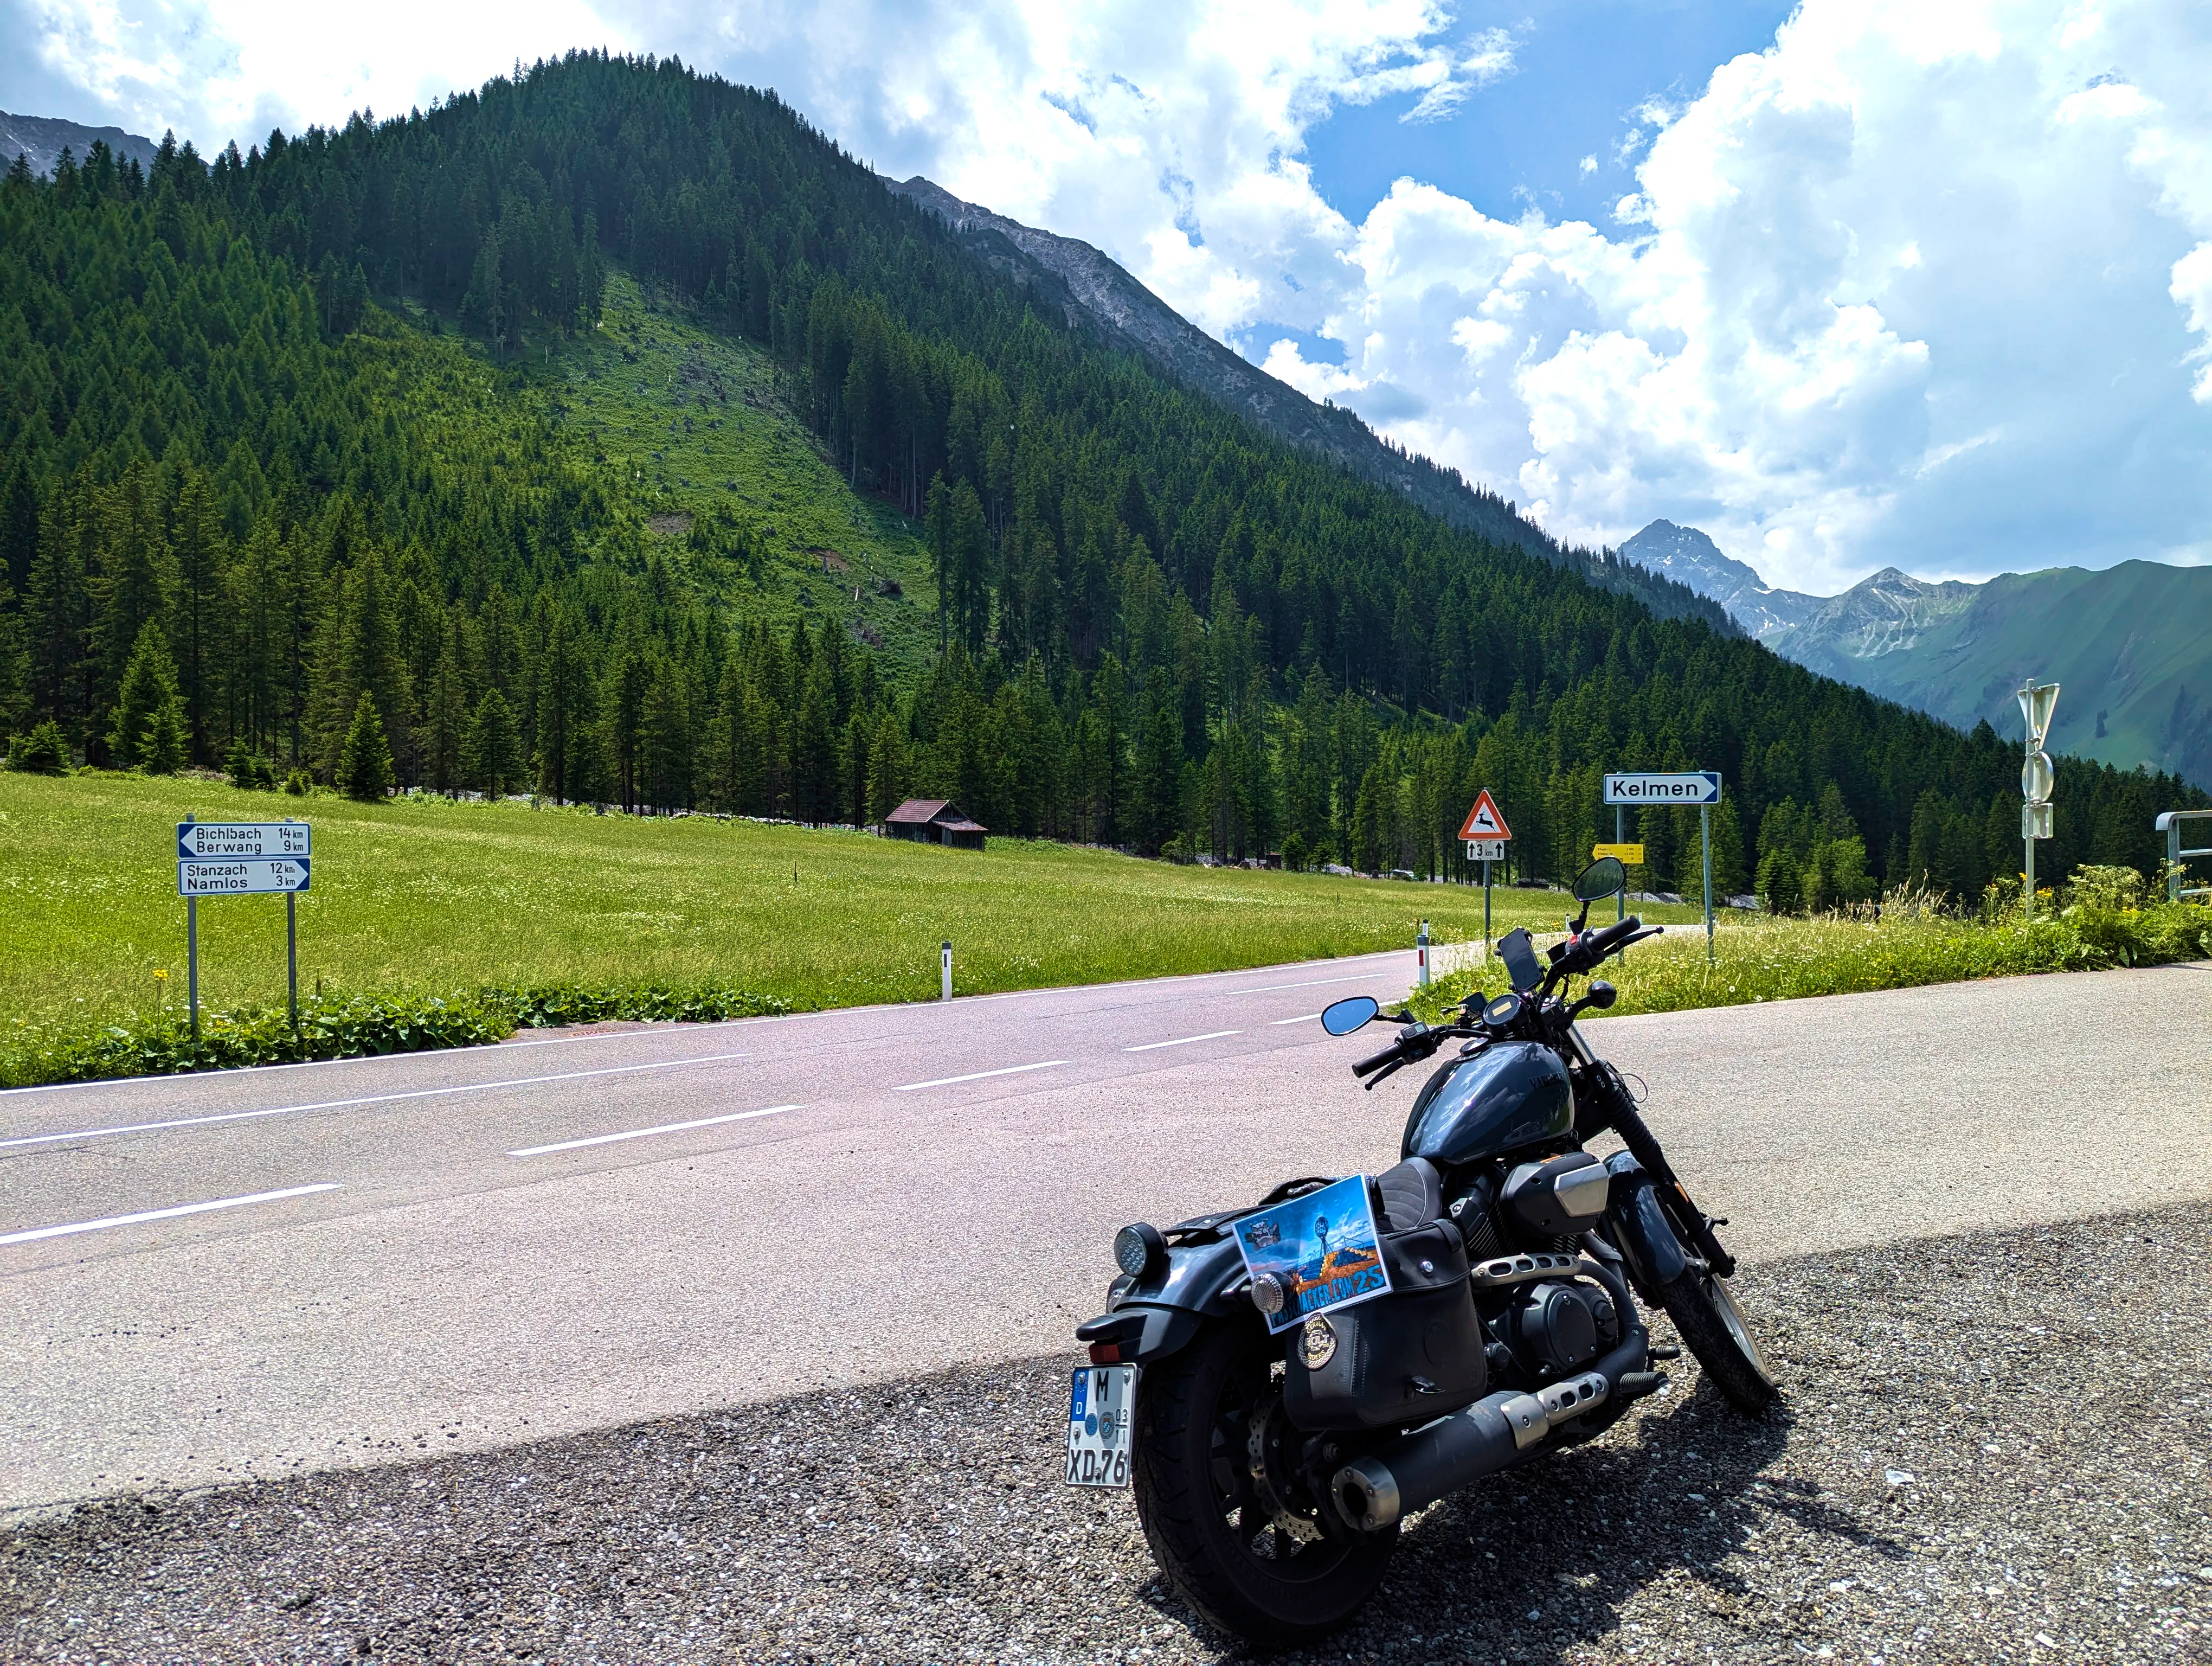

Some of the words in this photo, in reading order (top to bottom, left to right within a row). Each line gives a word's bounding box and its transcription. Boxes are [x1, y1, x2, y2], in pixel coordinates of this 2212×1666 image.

[1613, 780, 1698, 797] Kelmen
[196, 827, 261, 840] Bichlbach
[278, 827, 291, 839] 14
[293, 830, 303, 839] km
[197, 841, 261, 855] Berwang
[284, 840, 291, 851] 9
[293, 842, 304, 851] km
[1476, 844, 1483, 856] 3
[187, 863, 247, 876] Stanzach
[270, 862, 283, 874] 12
[285, 864, 295, 874] km
[188, 877, 248, 890] Namlos
[276, 875, 283, 887] 3
[285, 877, 295, 886] km
[1304, 1334, 1329, 1347] BOLT
[1096, 1370, 1109, 1401] M
[1076, 1401, 1083, 1414] D
[1115, 1408, 1128, 1423] 03
[1115, 1428, 1126, 1444] 11
[1068, 1449, 1096, 1482] XD
[1101, 1449, 1126, 1483] 76
